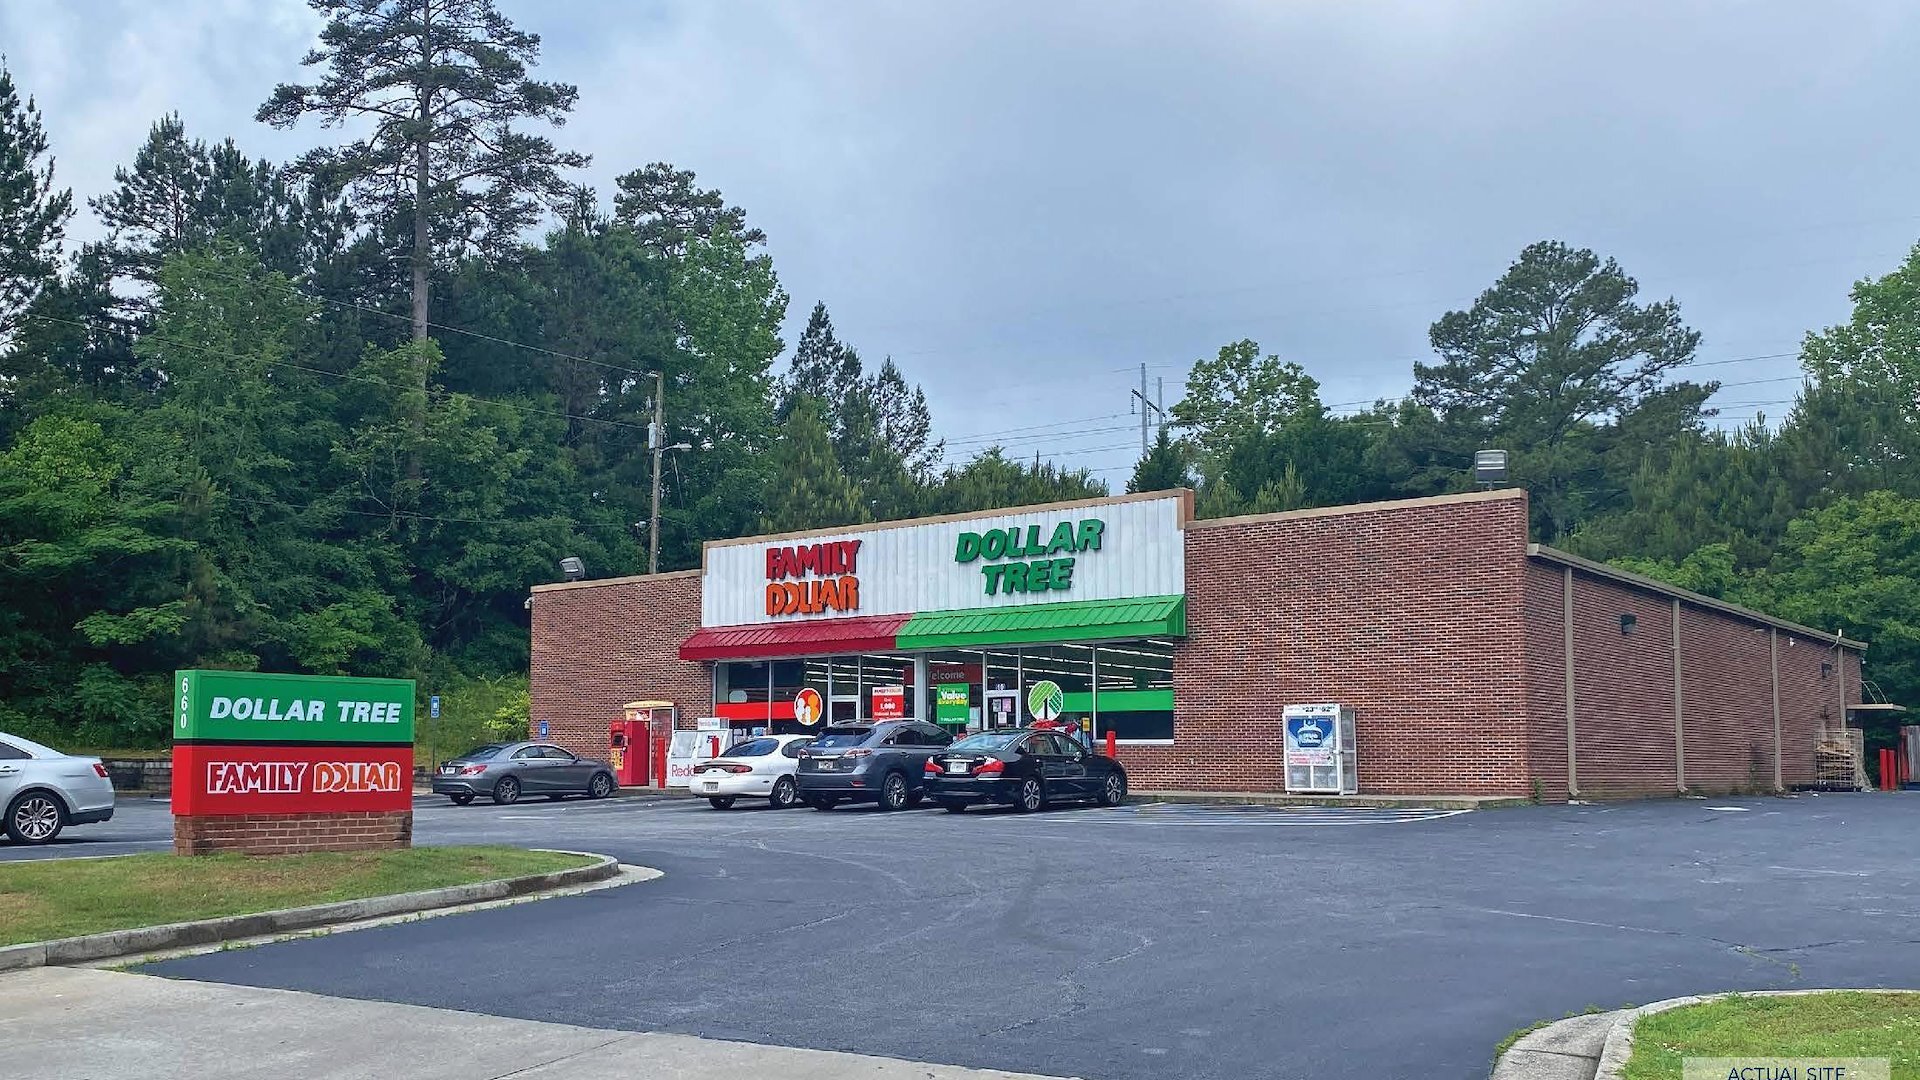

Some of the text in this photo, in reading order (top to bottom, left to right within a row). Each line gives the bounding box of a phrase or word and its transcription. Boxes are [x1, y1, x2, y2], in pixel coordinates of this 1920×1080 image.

[955, 519, 1105, 562] DOLLAR
[766, 540, 862, 580] FAMILY
[982, 558, 1075, 595] TREE
[766, 576, 859, 617] DOLLAR
[929, 670, 965, 680] elcome
[181, 677, 189, 729] 660
[209, 697, 402, 724] DOLLAR TREE
[941, 690, 967, 700] Value
[207, 762, 401, 794] FAMILY DOLLAR
